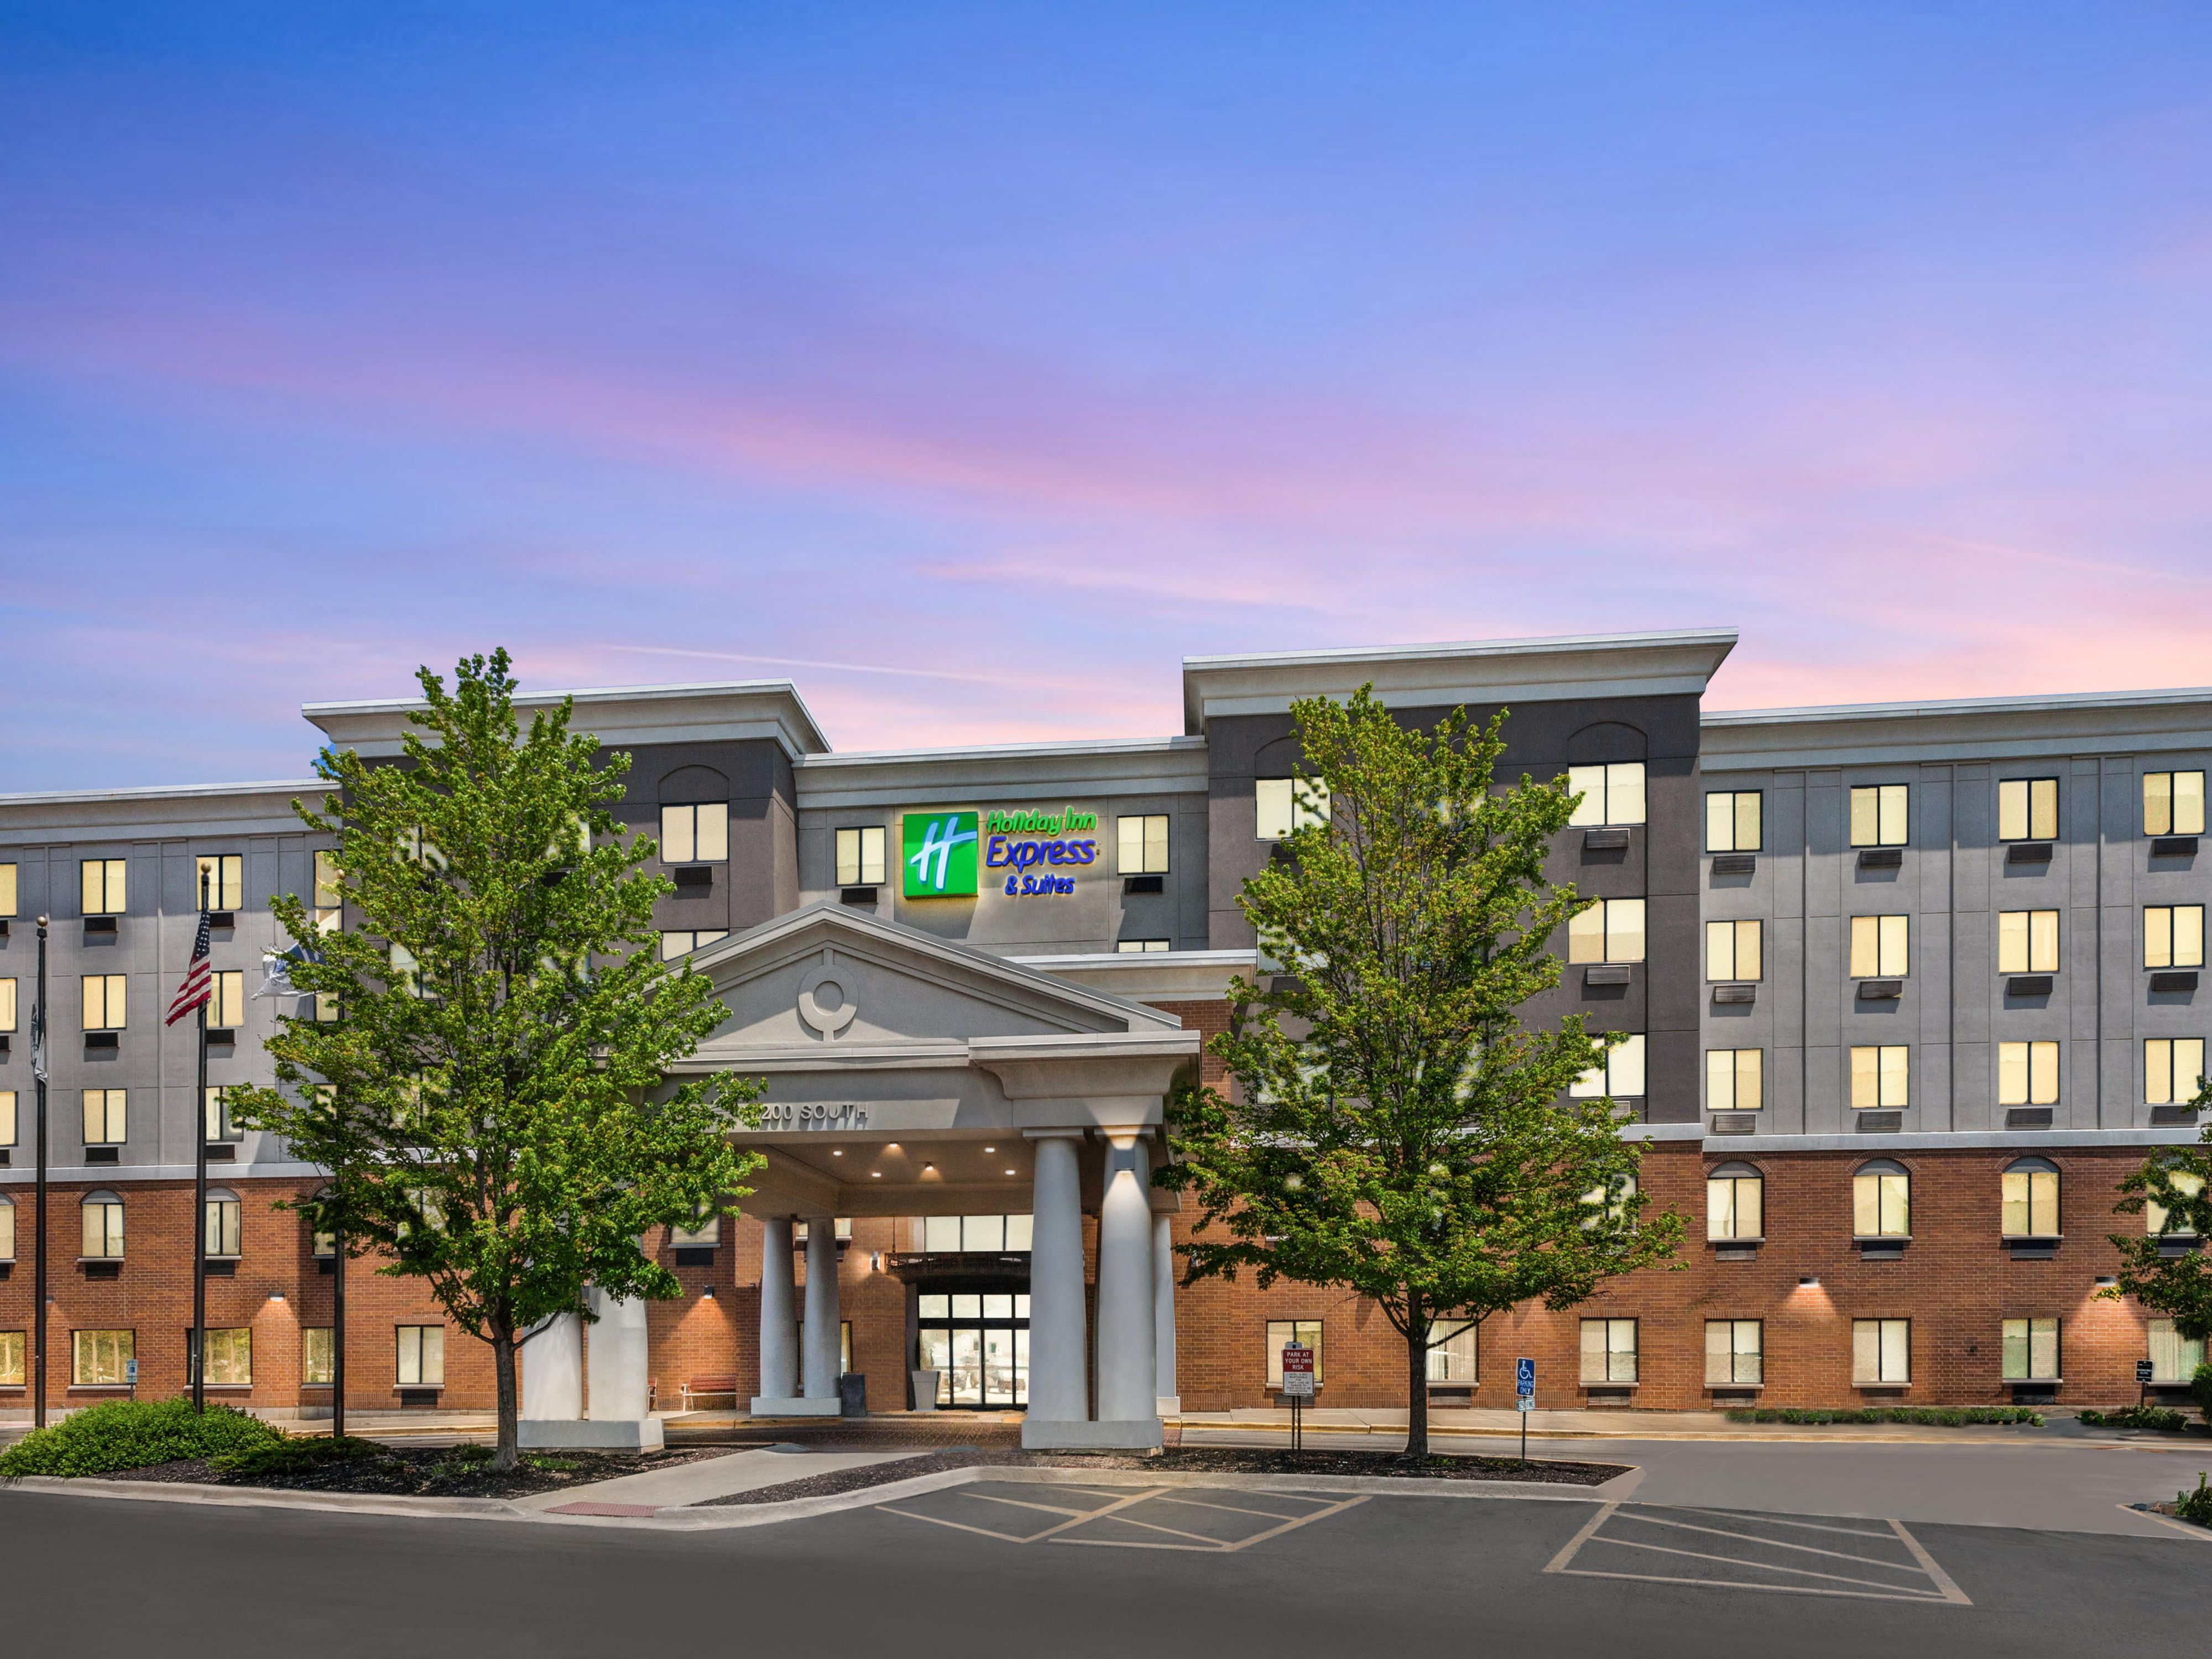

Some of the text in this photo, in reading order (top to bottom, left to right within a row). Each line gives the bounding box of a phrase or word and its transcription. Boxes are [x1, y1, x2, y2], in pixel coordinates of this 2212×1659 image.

[987, 806, 1097, 835] Holiday Inn
[986, 836, 1096, 873] Express
[1004, 874, 1075, 895] & Suites
[801, 1103, 868, 1119] SOUTH
[1517, 1379, 1533, 1388] PARKING
